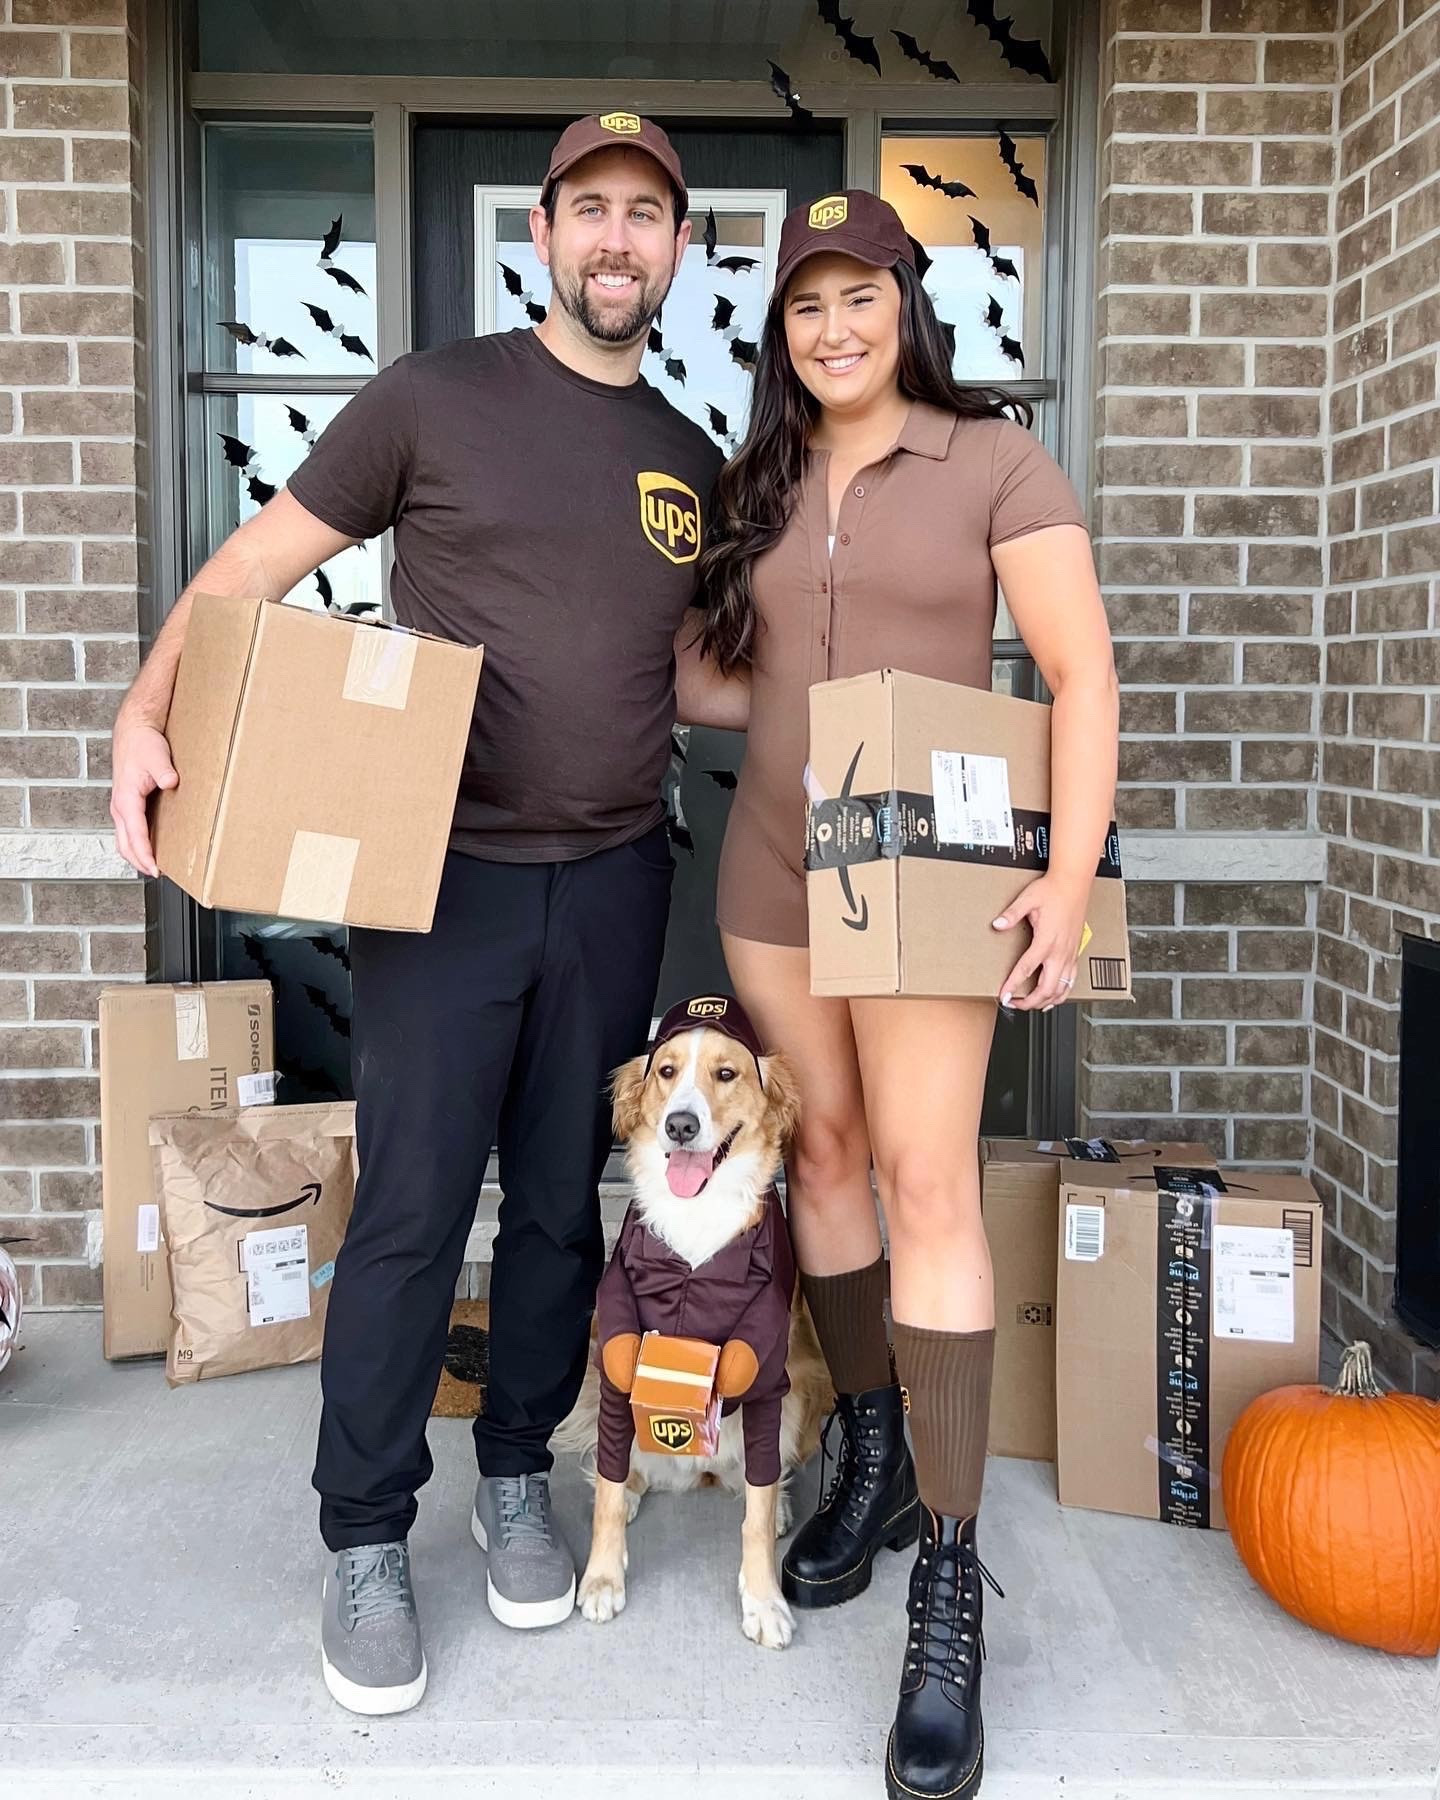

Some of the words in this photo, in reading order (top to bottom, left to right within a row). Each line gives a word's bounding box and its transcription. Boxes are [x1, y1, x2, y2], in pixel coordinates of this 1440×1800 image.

[604, 117, 638, 130] ups
[811, 205, 844, 226] ups
[646, 494, 697, 548] ups
[882, 807, 894, 843] prime
[1039, 826, 1048, 858] prime
[1111, 835, 1120, 866] prime
[690, 1003, 723, 1015] ups
[1169, 1268, 1199, 1281] prime
[177, 1349, 193, 1360] M9
[653, 1423, 691, 1444] ups
